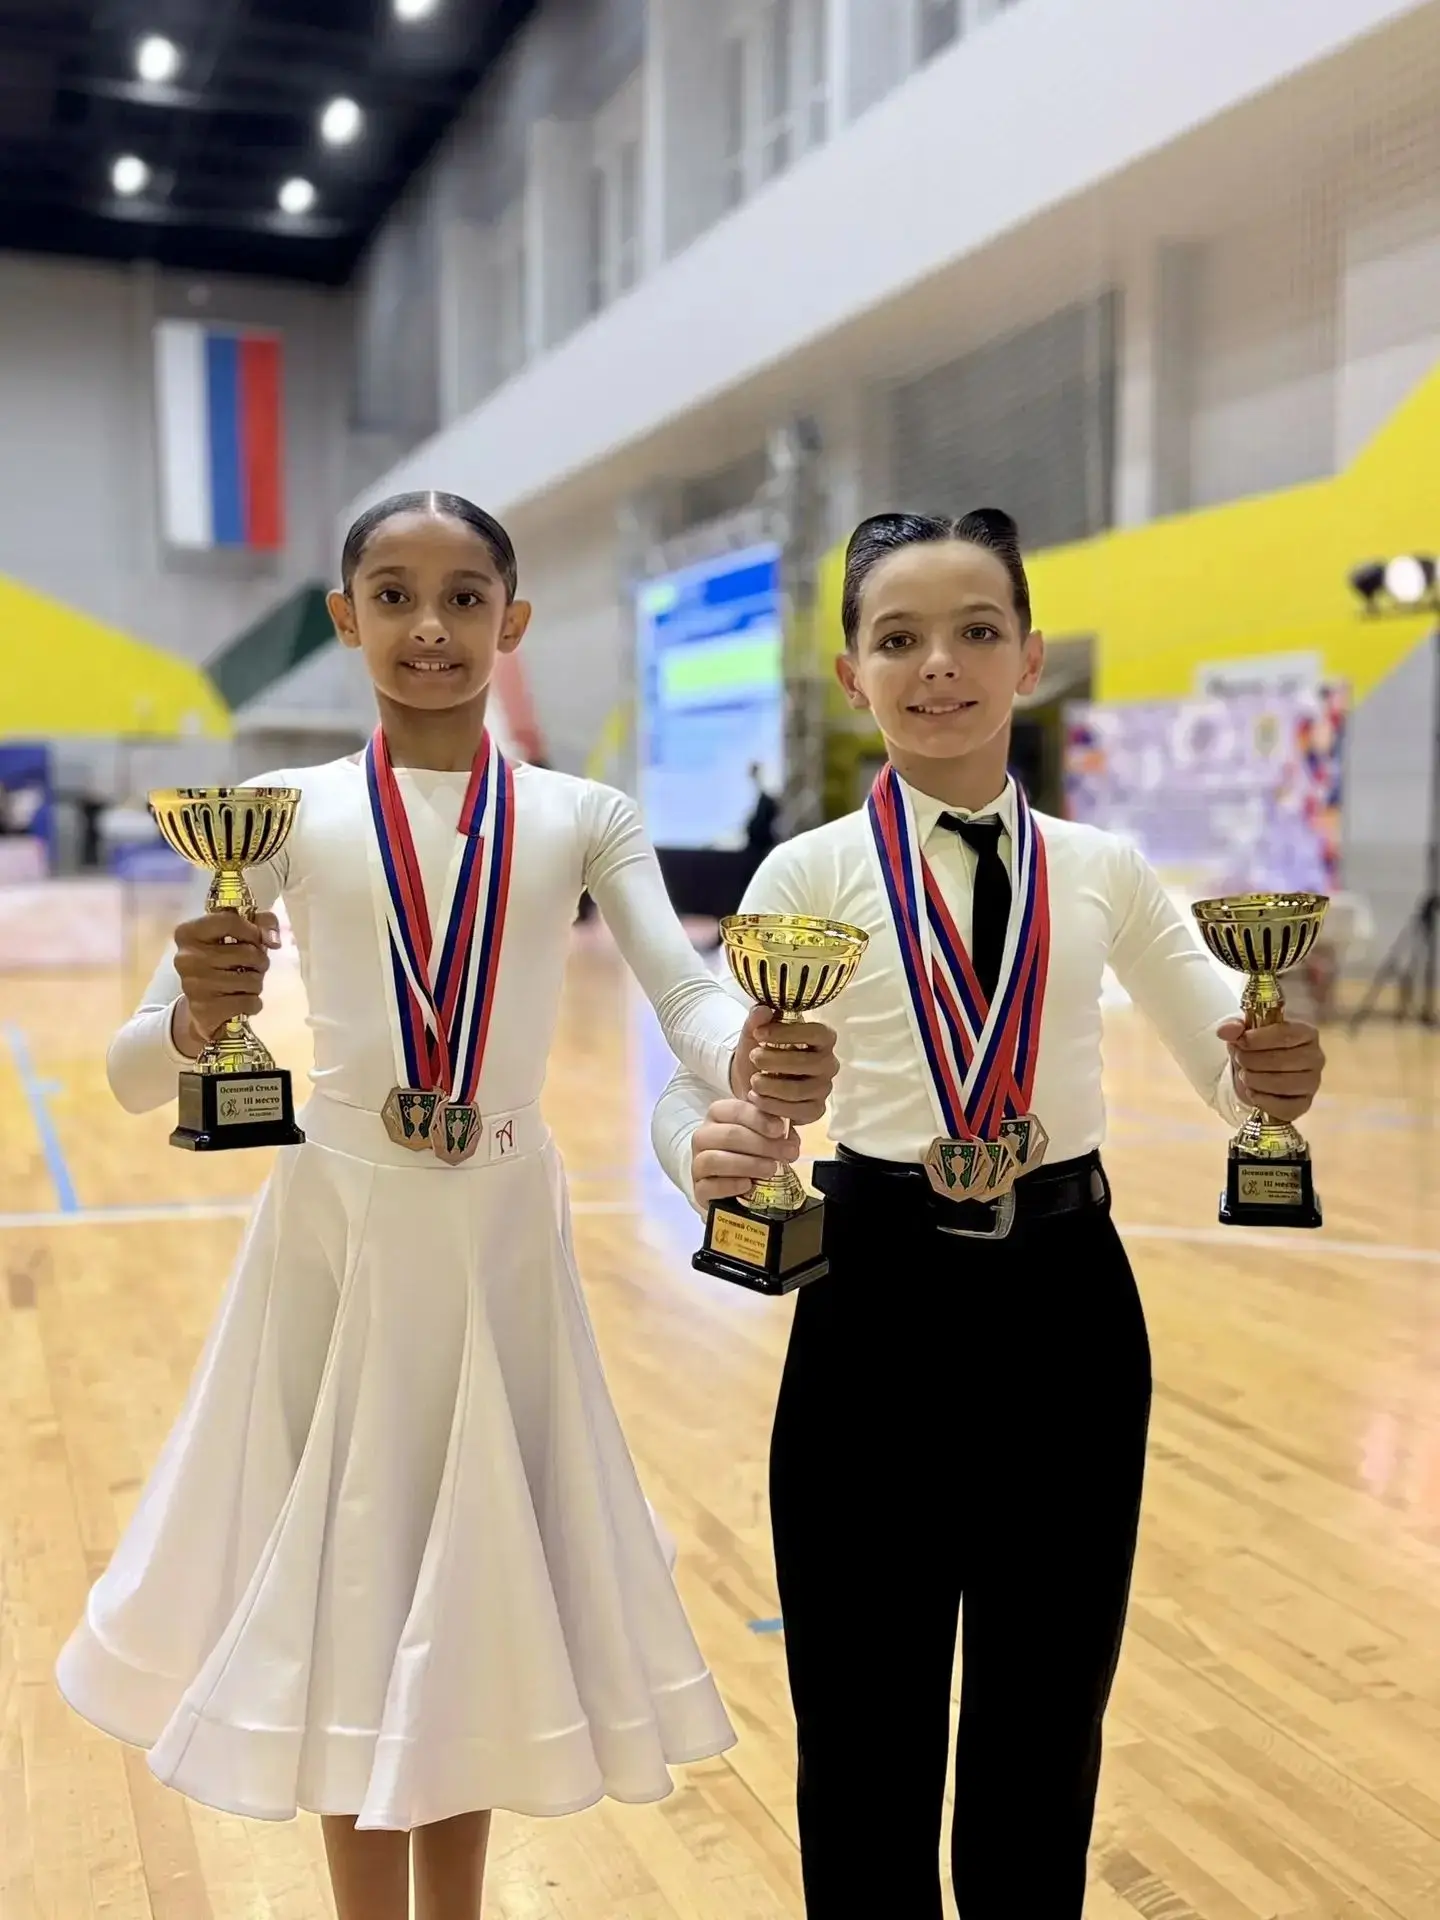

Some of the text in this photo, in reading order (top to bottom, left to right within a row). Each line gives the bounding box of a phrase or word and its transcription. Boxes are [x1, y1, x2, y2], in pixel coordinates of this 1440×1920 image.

[220, 1084, 278, 1094] Осенний Стиль
[243, 1096, 280, 1105] III место
[717, 1215, 745, 1230] Осенний
[744, 1236, 766, 1248] место
